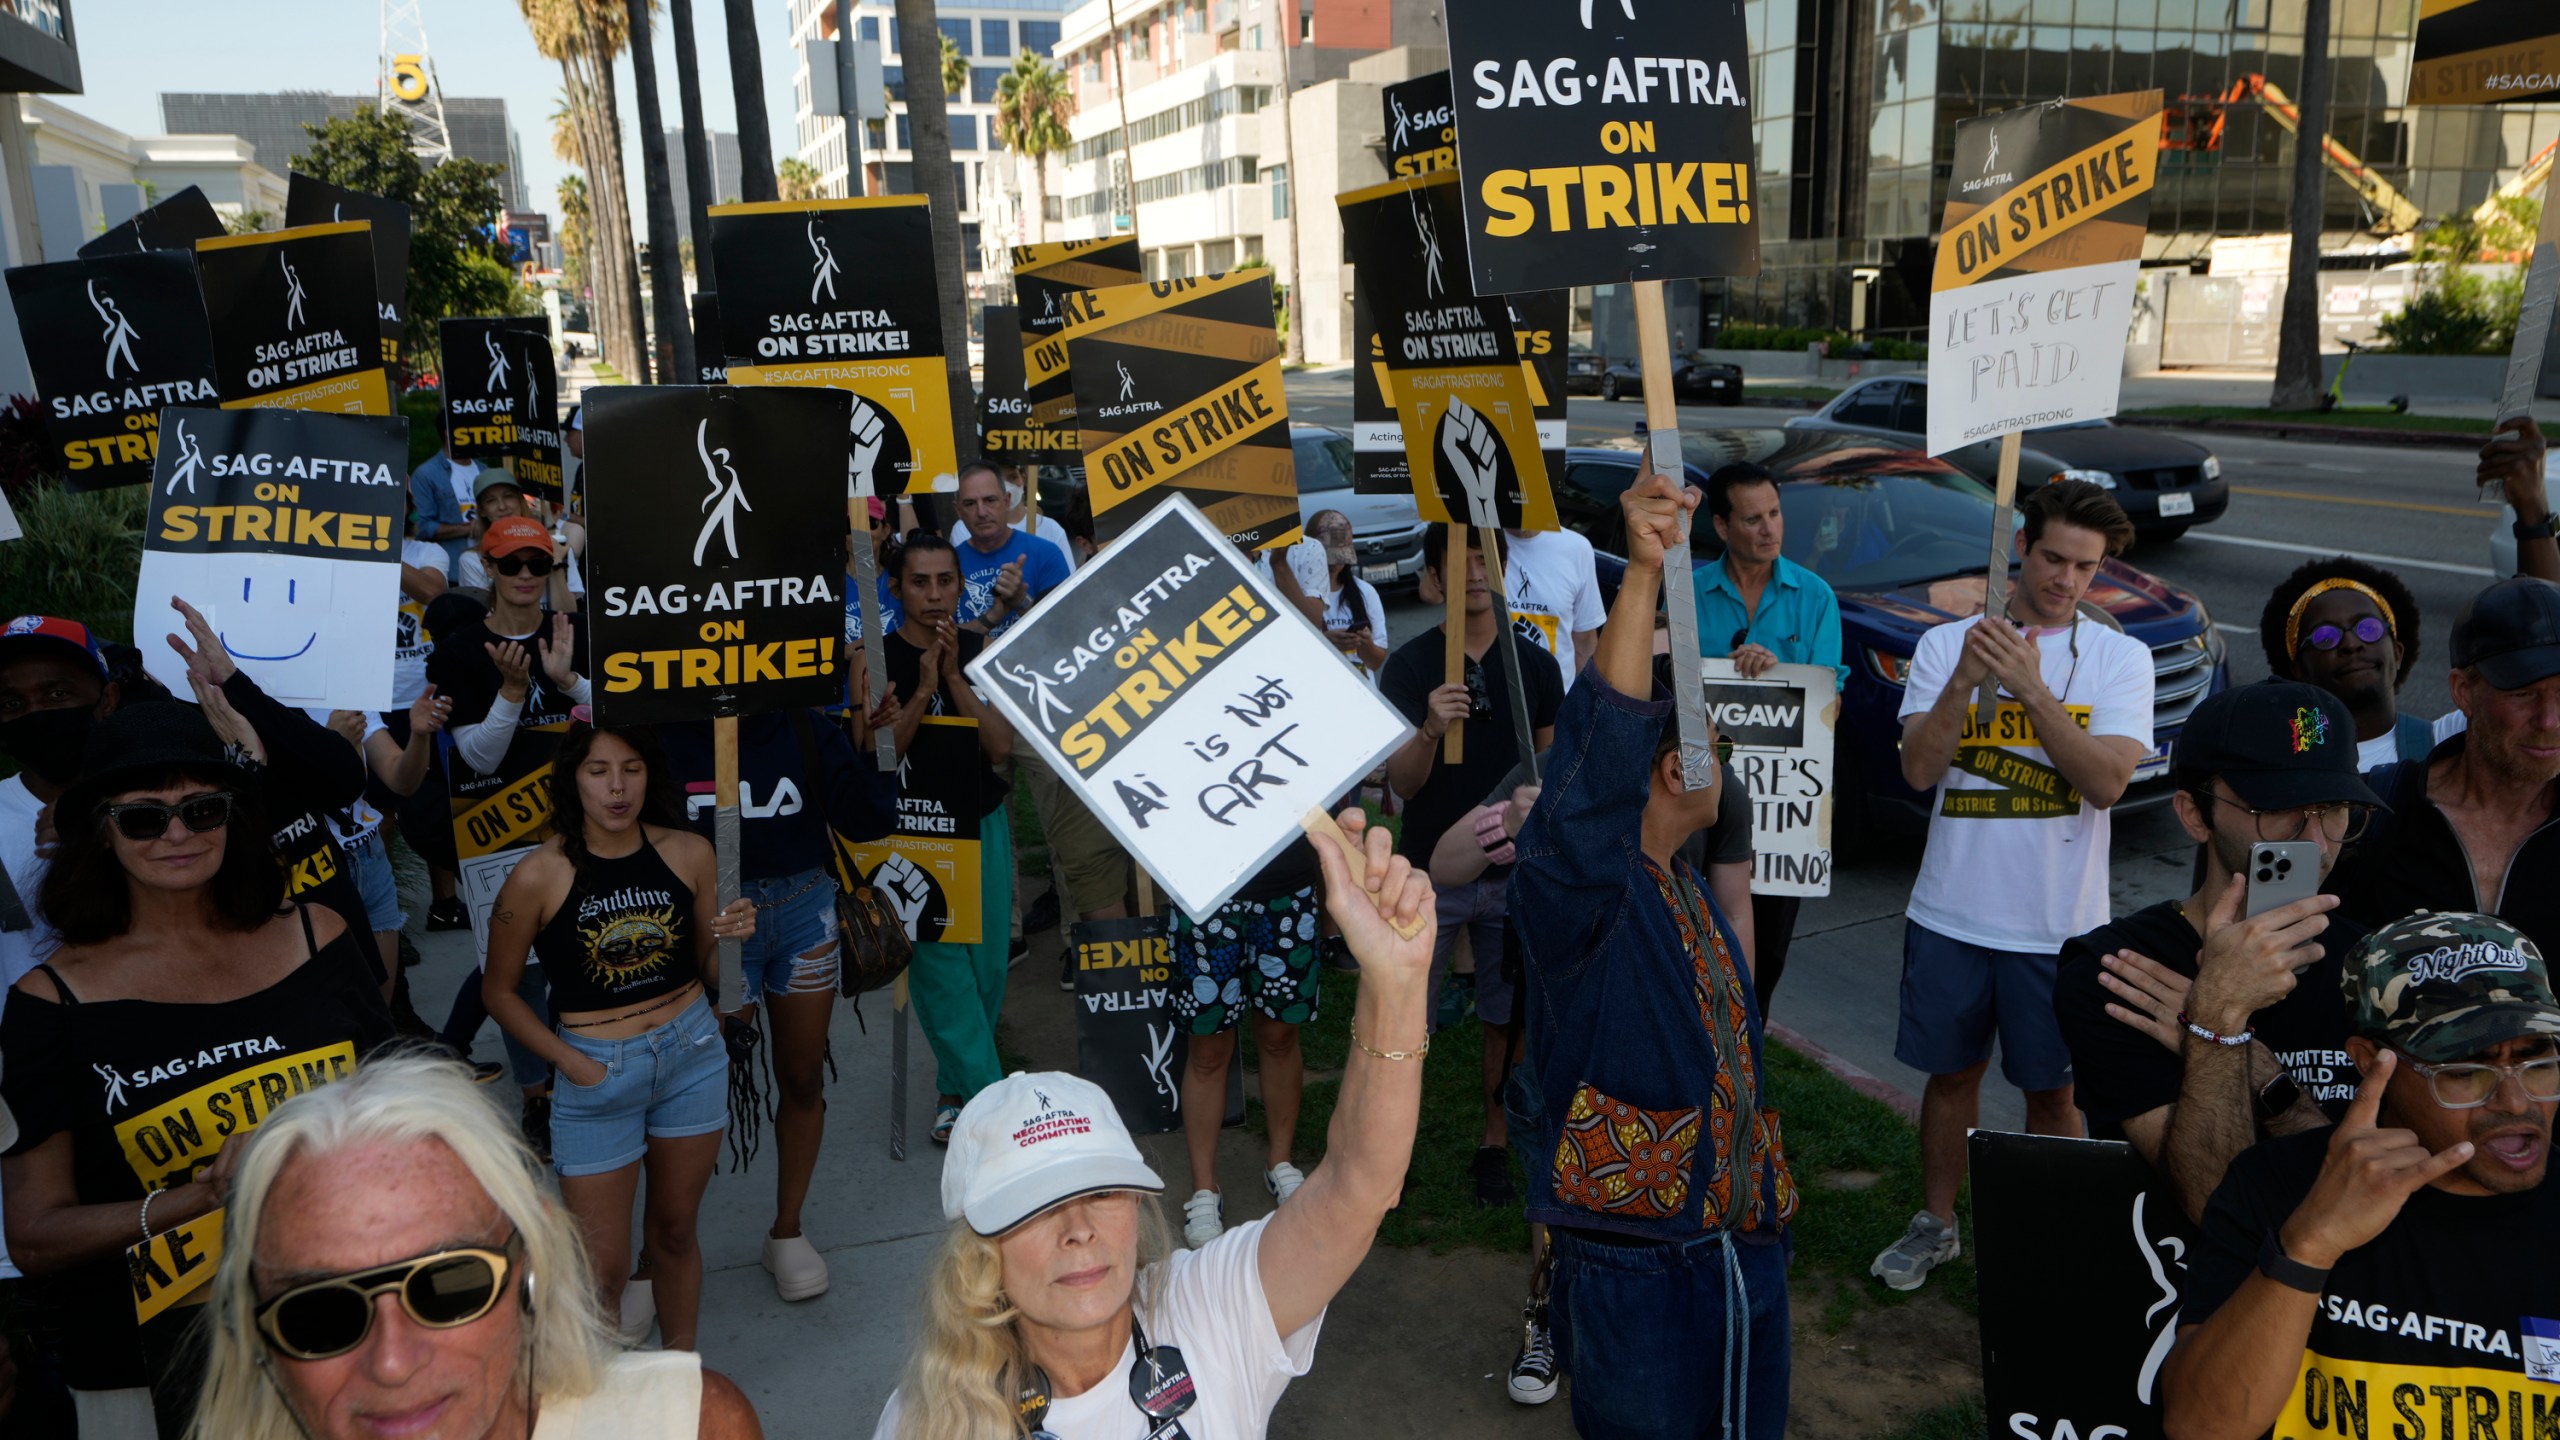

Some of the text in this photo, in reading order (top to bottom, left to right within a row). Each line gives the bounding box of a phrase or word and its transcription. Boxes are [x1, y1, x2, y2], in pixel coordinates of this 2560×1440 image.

[389, 54, 428, 101] 5
[1600, 121, 1656, 154] ON
[1481, 162, 1750, 237] STRIKE!
[1955, 139, 2140, 275] ON STRIKE
[1946, 281, 2117, 351] LET'S GET
[758, 330, 910, 358] ON STRIKE!
[1403, 334, 1430, 361] ON
[1432, 334, 1499, 360] STRIKE!
[247, 369, 280, 389] ON
[286, 348, 359, 381] STRIKE!
[764, 364, 911, 384] #SAGAFTRASTRONG
[1412, 373, 1505, 390] #SAGAFTRASTRONG
[125, 412, 158, 431] ON
[492, 414, 512, 425] ON
[1101, 378, 1274, 491] ON STRIKE
[1963, 407, 2073, 440] #SAGAFTRASTRONG
[64, 429, 158, 471] STRI
[1369, 432, 1404, 443] Acting
[533, 449, 543, 460] ON
[519, 457, 562, 488] STRIKE!
[254, 483, 299, 503] ON
[160, 505, 392, 551] STRIKE!
[970, 568, 995, 580] GUILD
[699, 620, 744, 642] ON
[603, 637, 835, 693] STRIKE!
[1114, 627, 1159, 670] ON
[1059, 584, 1267, 770] STRIKE!
[1184, 733, 1230, 762] is
[1198, 723, 1310, 826] ART
[1974, 750, 2057, 795] ON STRIKE
[685, 777, 804, 821] FLA
[1956, 797, 1996, 812] STRIKE
[2012, 797, 2029, 812] ON
[467, 806, 508, 848] ON
[898, 814, 955, 833] TRIKE!
[578, 886, 673, 922] Sublime
[1140, 968, 1169, 983] ON
[2292, 1067, 2334, 1083] UILD
[134, 1107, 203, 1167] ON
[1012, 1117, 1092, 1141] NEGOTIATING
[1019, 1126, 1091, 1147] COMMITTEE
[2305, 1367, 2368, 1434] ON
